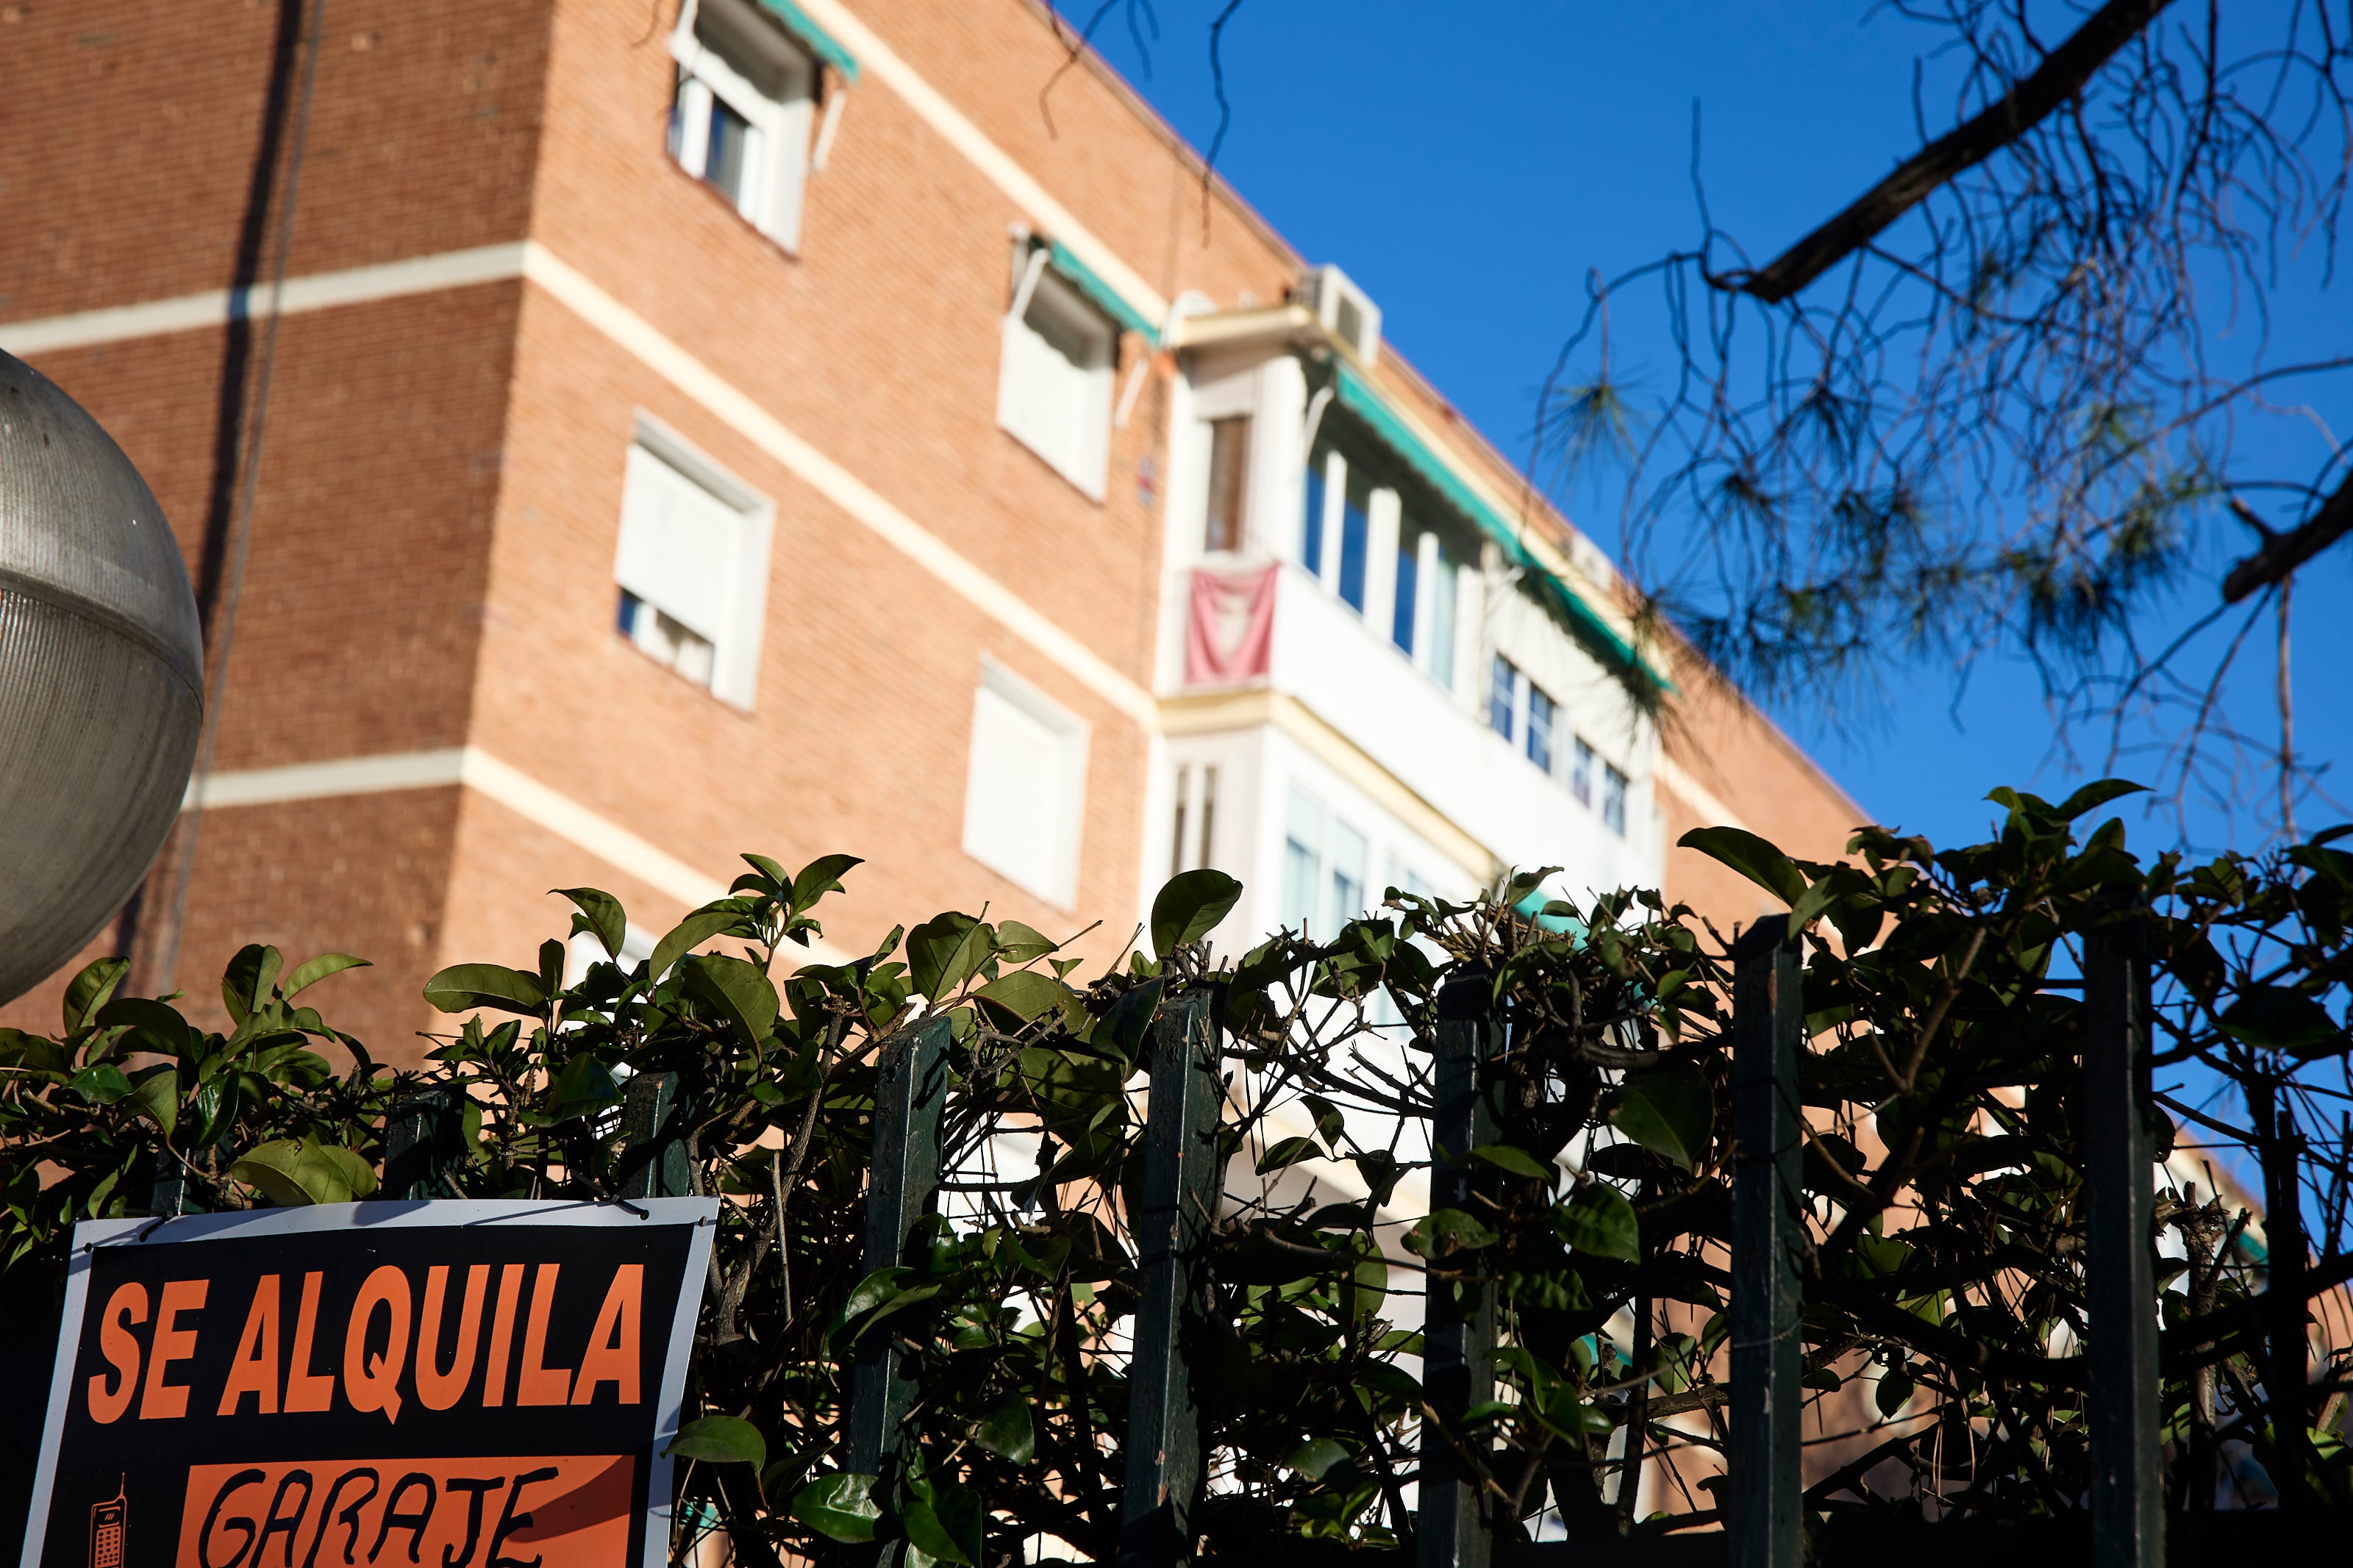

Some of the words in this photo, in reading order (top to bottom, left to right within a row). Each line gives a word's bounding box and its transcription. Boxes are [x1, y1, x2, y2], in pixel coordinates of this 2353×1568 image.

[88, 1279, 210, 1424] SE
[217, 1264, 643, 1425] ALQUILA
[198, 1467, 559, 1568] GARAJE
